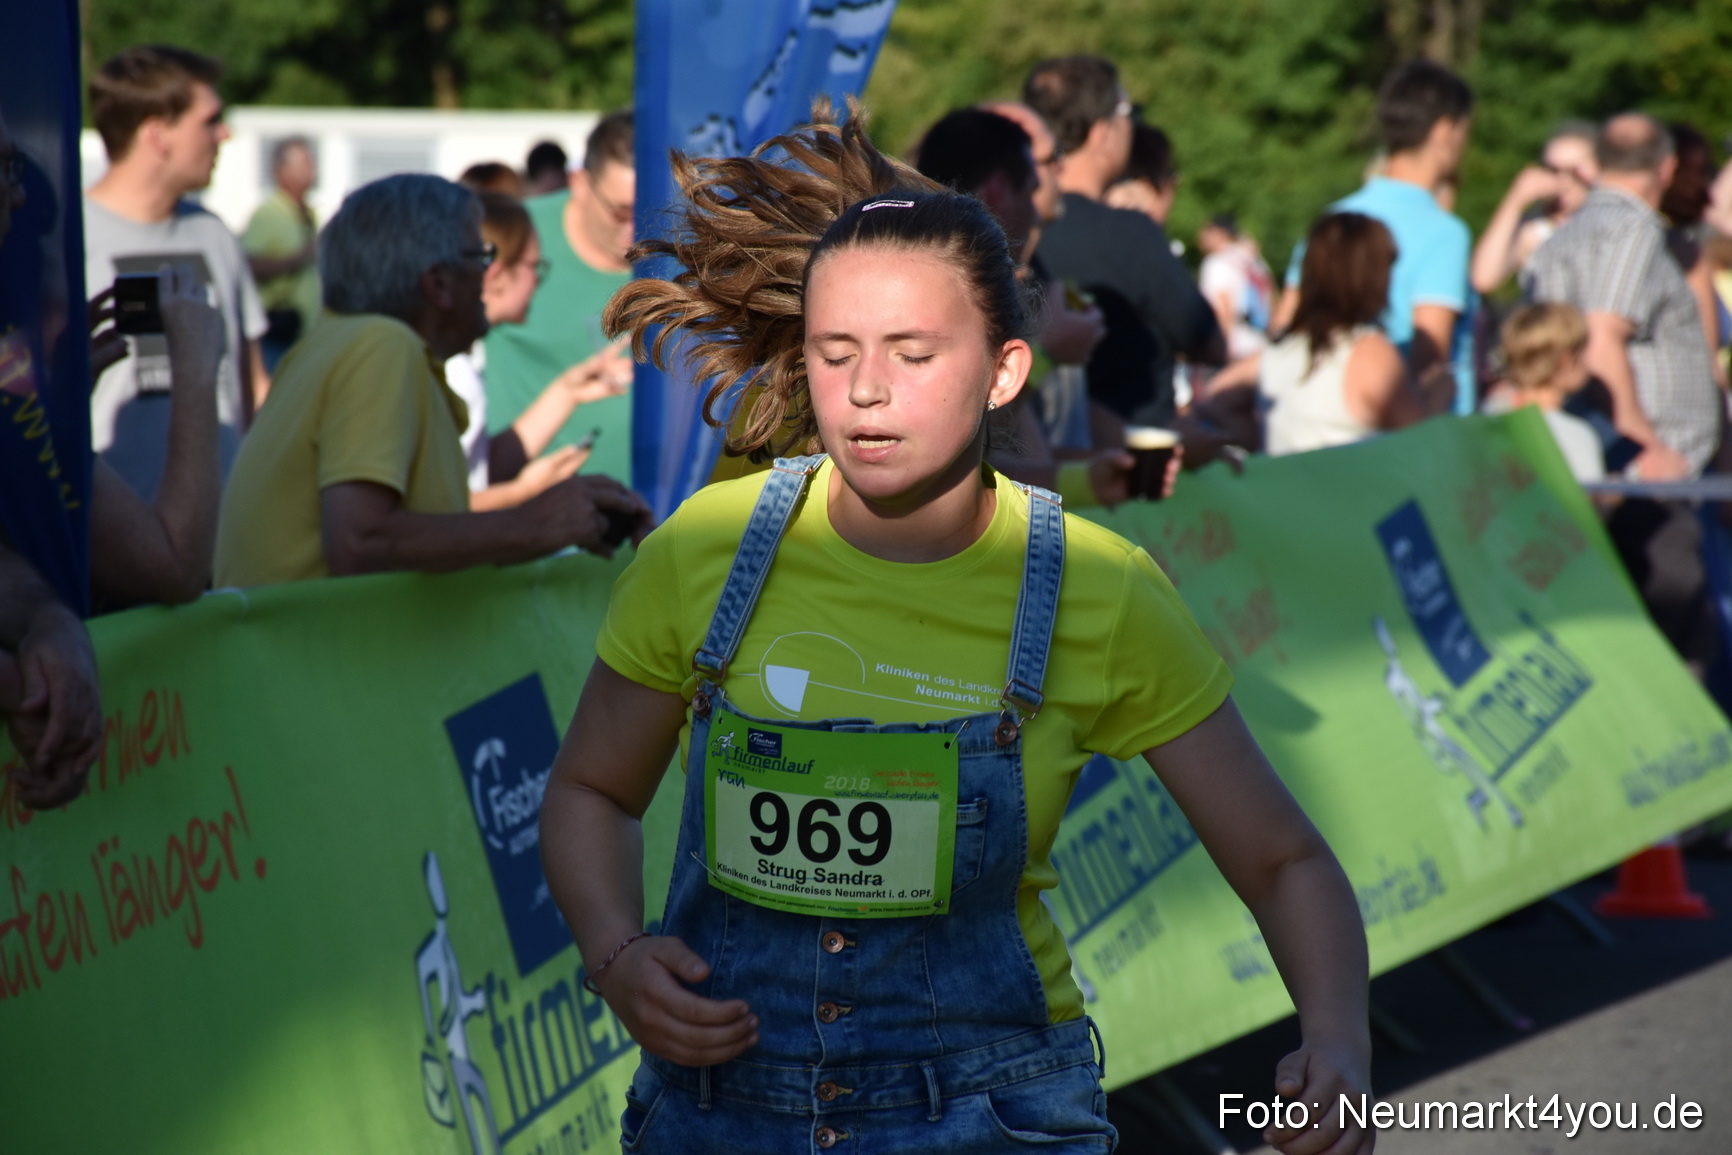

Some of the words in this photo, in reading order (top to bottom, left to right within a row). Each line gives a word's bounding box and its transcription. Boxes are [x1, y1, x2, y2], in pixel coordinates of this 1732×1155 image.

[875, 663, 930, 682] Kliniken
[934, 675, 955, 687] des
[915, 684, 981, 704] Neumarkt
[753, 736, 777, 747] Fischer
[733, 745, 816, 775] firmenlauf
[824, 775, 871, 791] 2018
[749, 792, 892, 866] 969
[90, 765, 268, 950] länger!
[717, 862, 749, 882] Kliniken
[751, 875, 768, 887] des
[770, 879, 832, 896] Landkreises
[835, 884, 886, 899] Neumarkt
[889, 889, 895, 898] i.
[897, 889, 907, 898] d.
[910, 888, 933, 898] OPf.
[757, 859, 807, 885] Strug
[813, 867, 884, 886] Sandra
